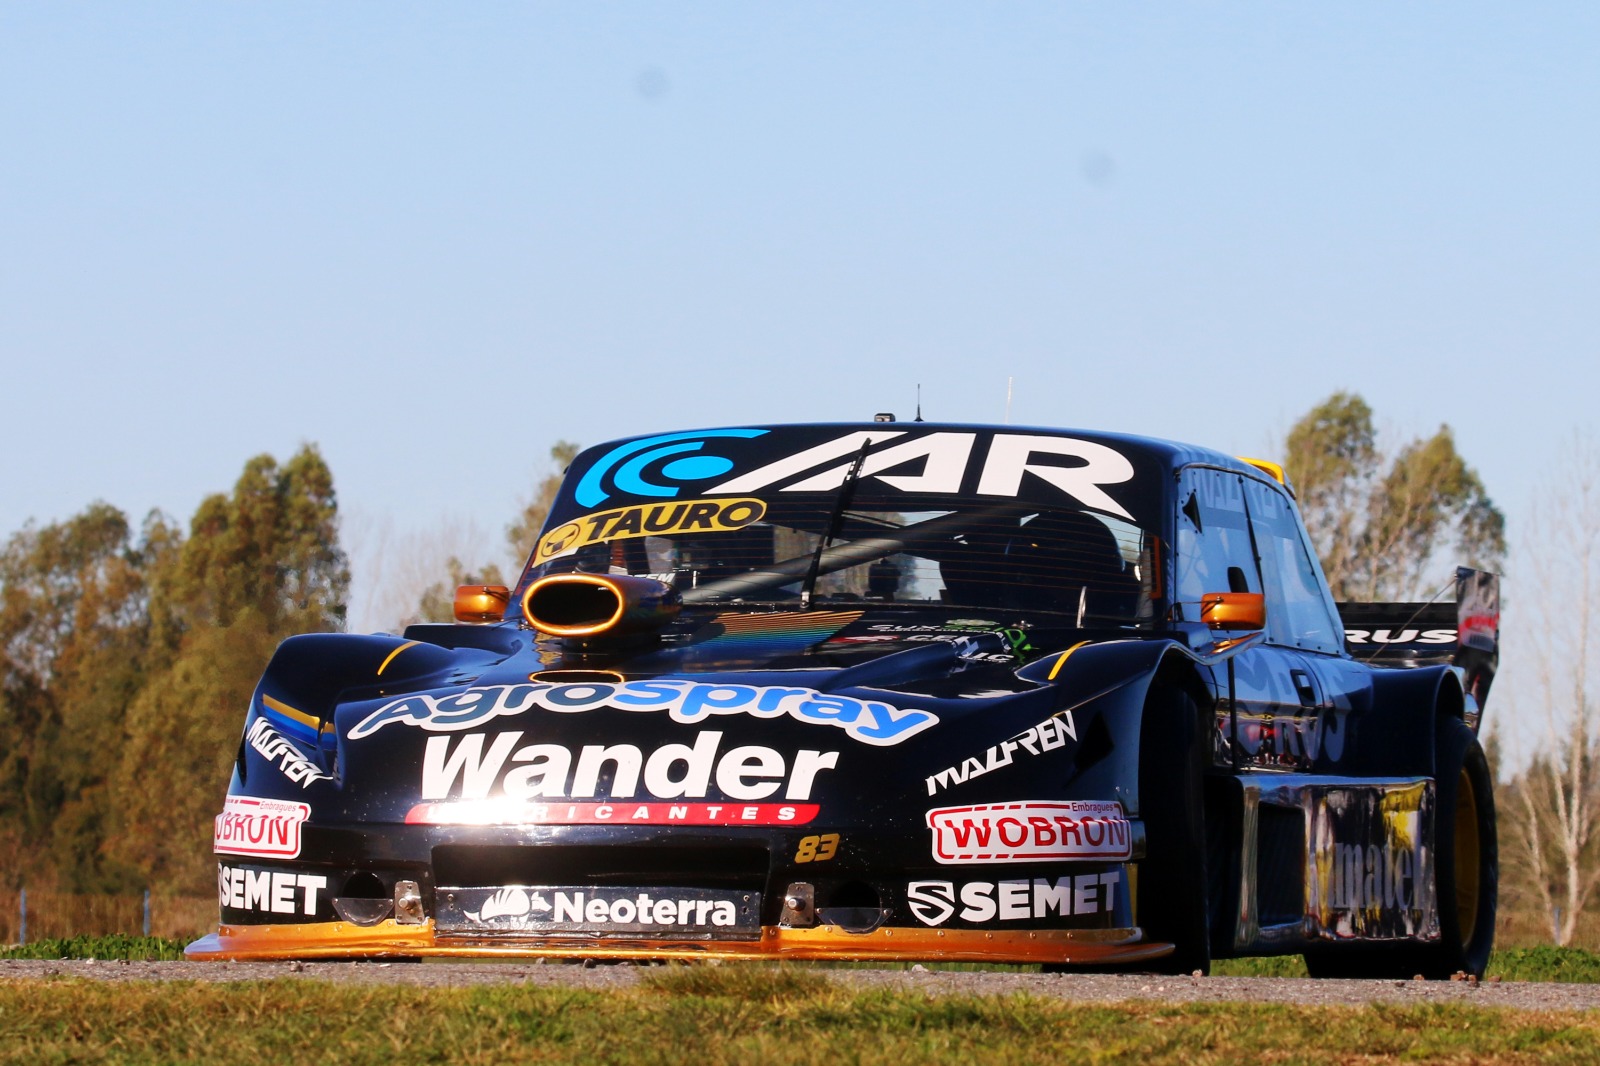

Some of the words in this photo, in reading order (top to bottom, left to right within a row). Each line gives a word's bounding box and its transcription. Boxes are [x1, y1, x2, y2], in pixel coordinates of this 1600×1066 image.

[586, 501, 764, 541] TAURO
[422, 731, 840, 801] Wander
[1071, 802, 1114, 814] Embragues
[794, 833, 840, 863] 83
[944, 816, 1126, 848] WOBRON
[219, 867, 327, 916] SEMET
[554, 891, 736, 927] Neoterra
[959, 871, 1120, 923] SEMET
